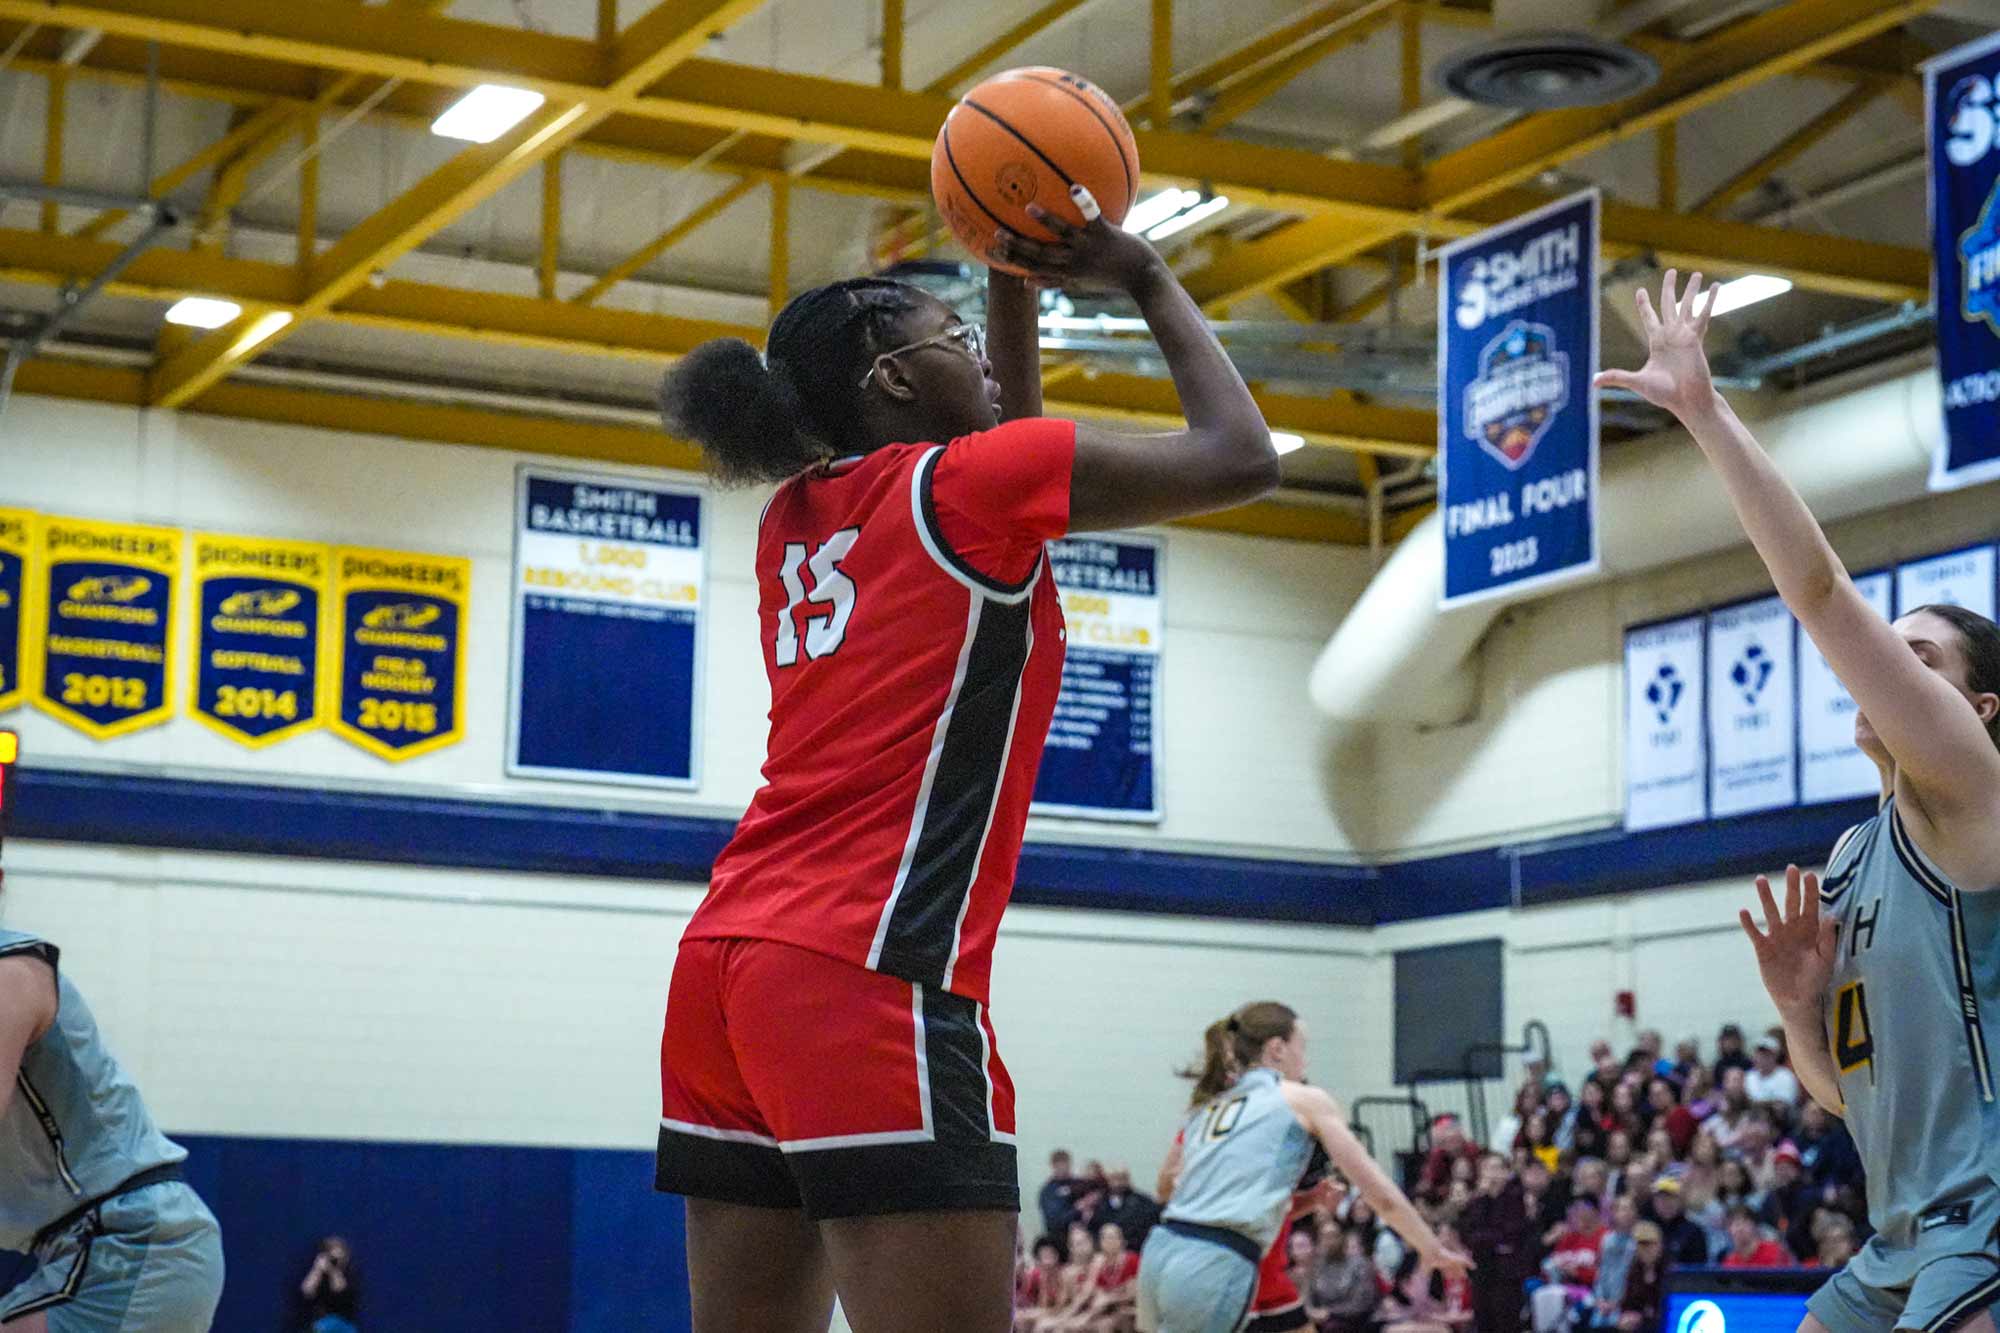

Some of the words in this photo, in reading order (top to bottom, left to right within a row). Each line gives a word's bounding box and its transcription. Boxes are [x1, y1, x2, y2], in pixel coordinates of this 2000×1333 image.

[1489, 222, 1579, 291] SMITH
[573, 483, 657, 517] SMITH
[1447, 491, 1515, 539] FINAL
[1521, 468, 1586, 518] FOUR
[531, 504, 697, 547] BASKETBALL
[46, 527, 174, 561] PIONEERS
[198, 543, 321, 577] PIONEERS
[579, 543, 648, 569] 1,000
[343, 556, 462, 592] PIONEERS
[524, 566, 635, 596] REBOUND
[639, 579, 698, 603] CLUB
[775, 524, 861, 668] 15
[211, 649, 305, 675] SOFTBALL
[62, 672, 146, 709] 2012
[214, 684, 297, 720] 2014
[358, 697, 437, 733] 2015
[1201, 1096, 1249, 1144] 10
